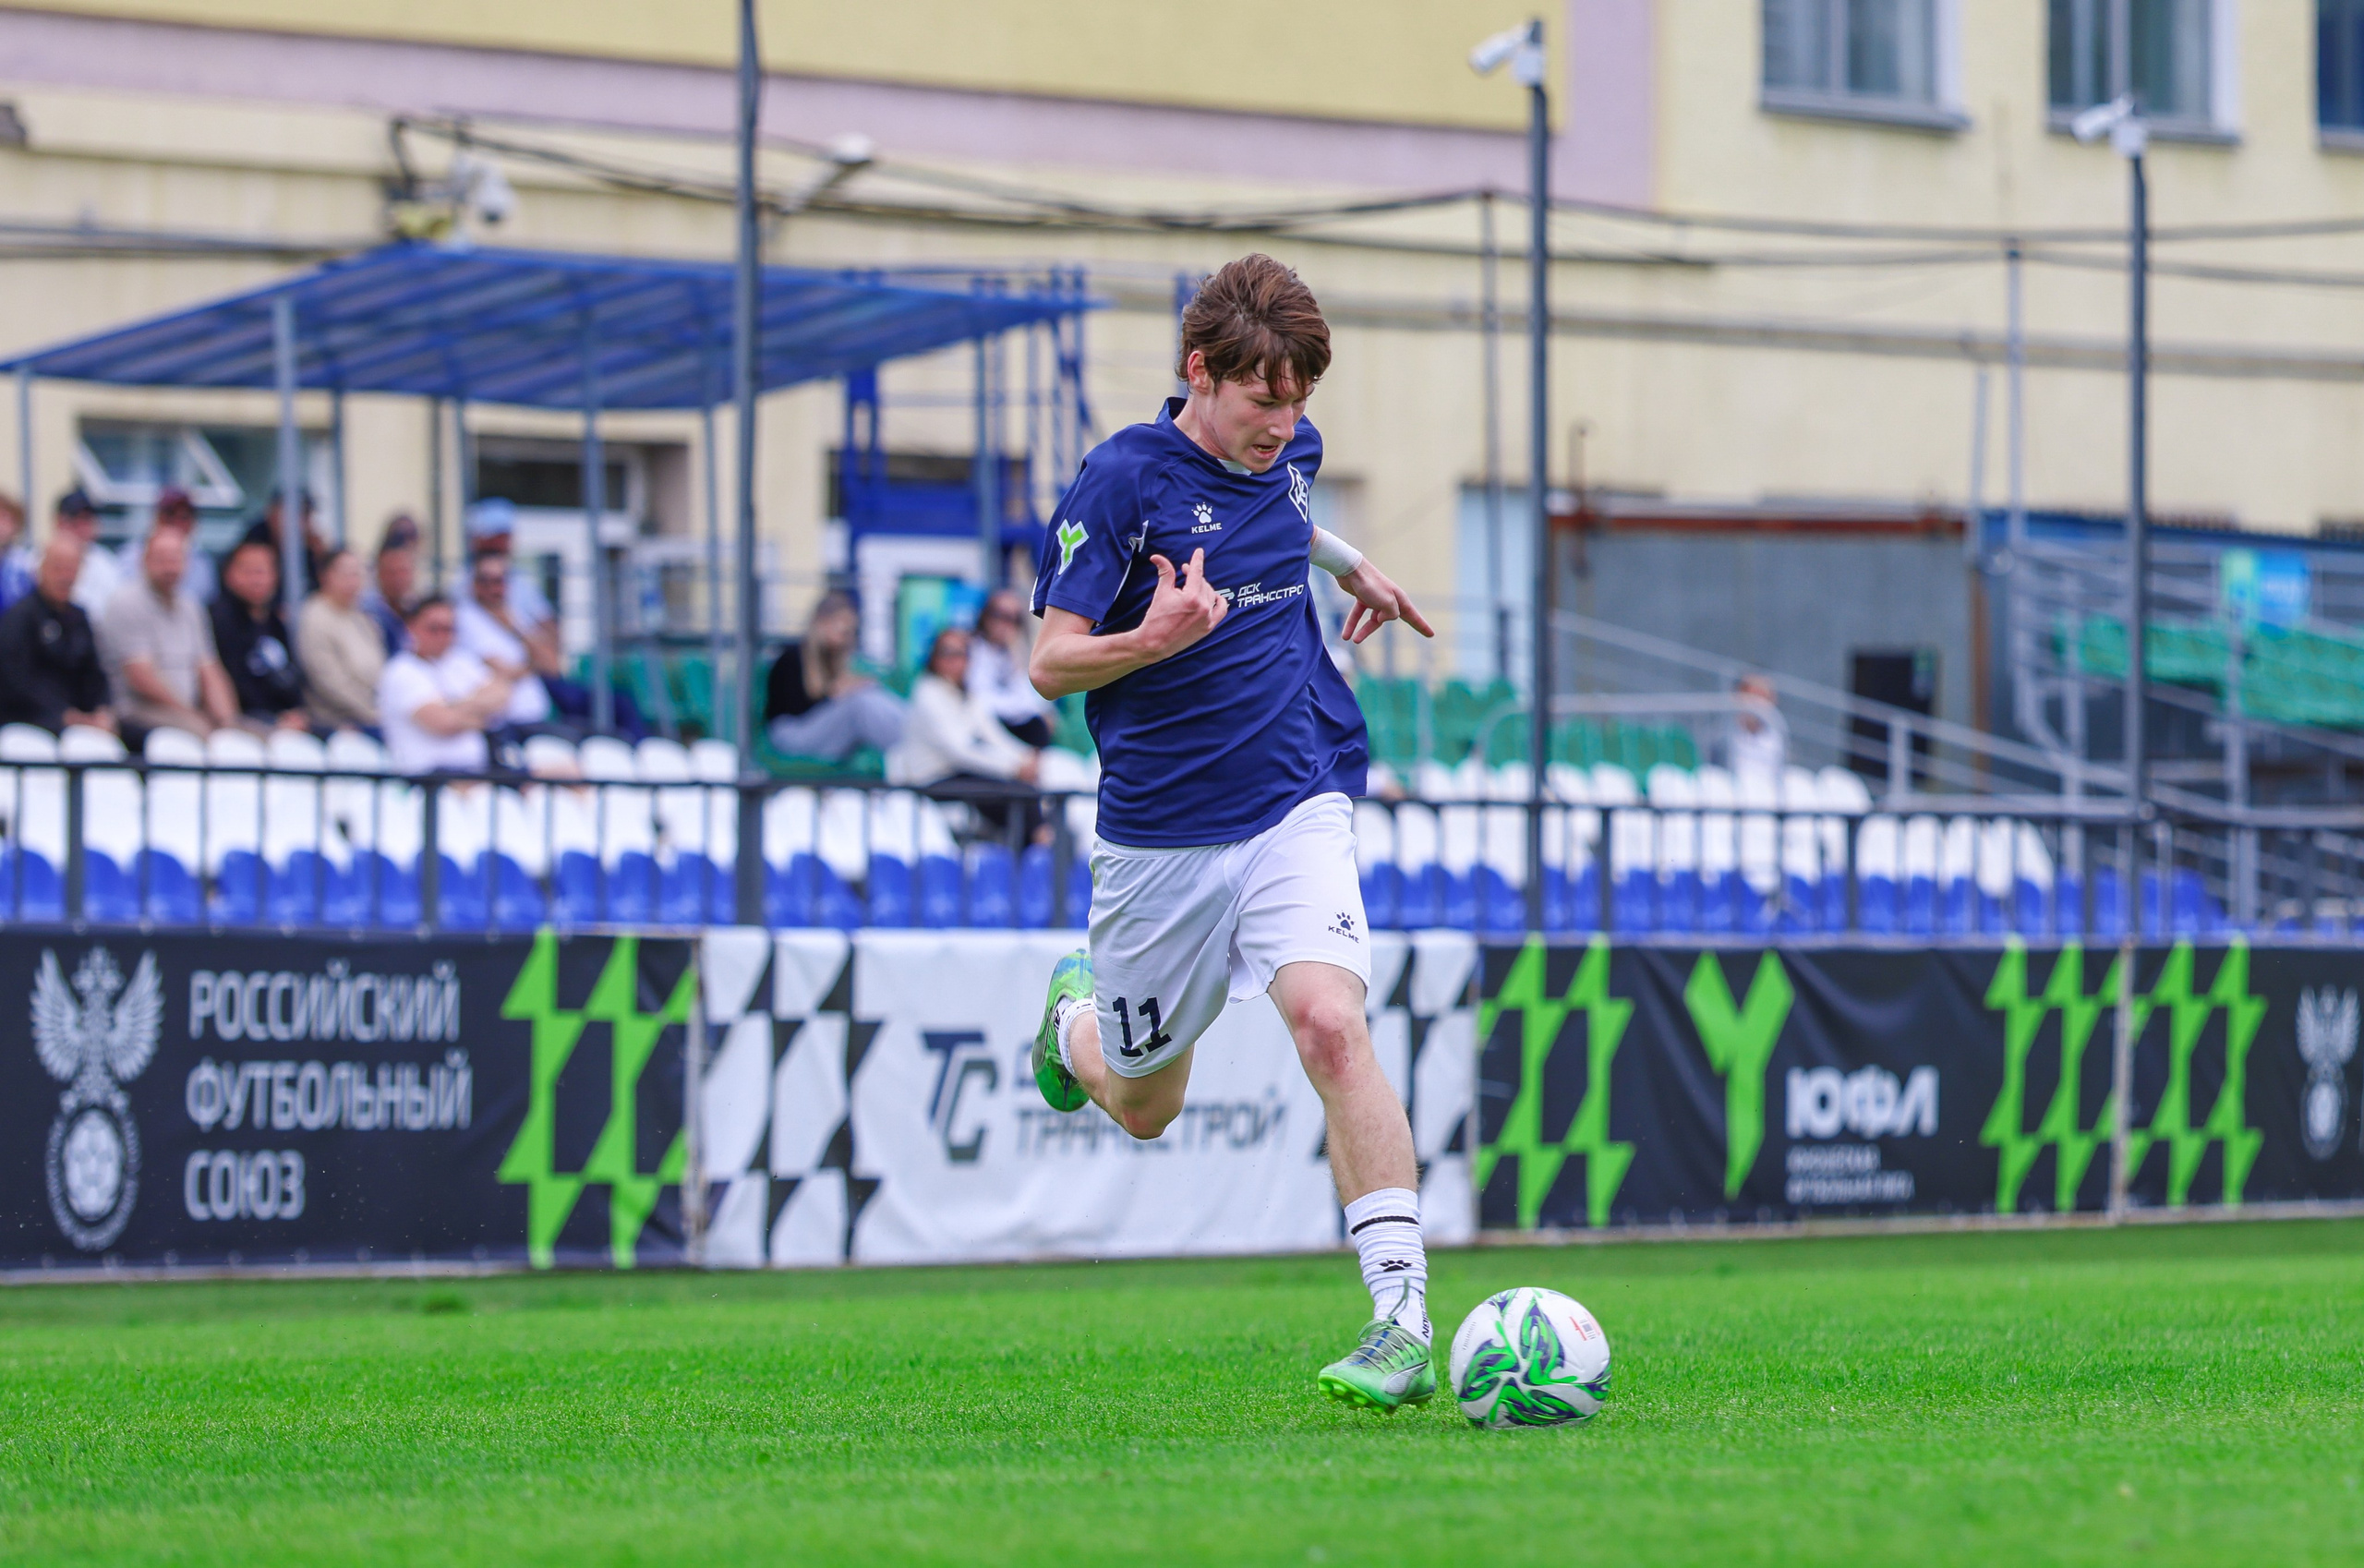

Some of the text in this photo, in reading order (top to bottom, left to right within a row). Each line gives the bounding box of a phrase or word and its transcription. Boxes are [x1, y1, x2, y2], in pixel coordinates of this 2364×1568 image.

[1191, 523, 1223, 534] KELME
[1237, 582, 1262, 597] ДСК
[1237, 584, 1305, 609] ТРАНССТРО
[1327, 925, 1359, 944] KELME
[188, 959, 461, 1042] РОССИЙСКИЙ
[1112, 995, 1173, 1057] 11
[186, 1047, 473, 1133] ФУТБОЛЬНЫЙ
[1016, 1082, 1290, 1156] ТРАНТРОЙ
[1786, 1064, 1939, 1140] ЮФЛ
[186, 1149, 306, 1221] СОЮЗ
